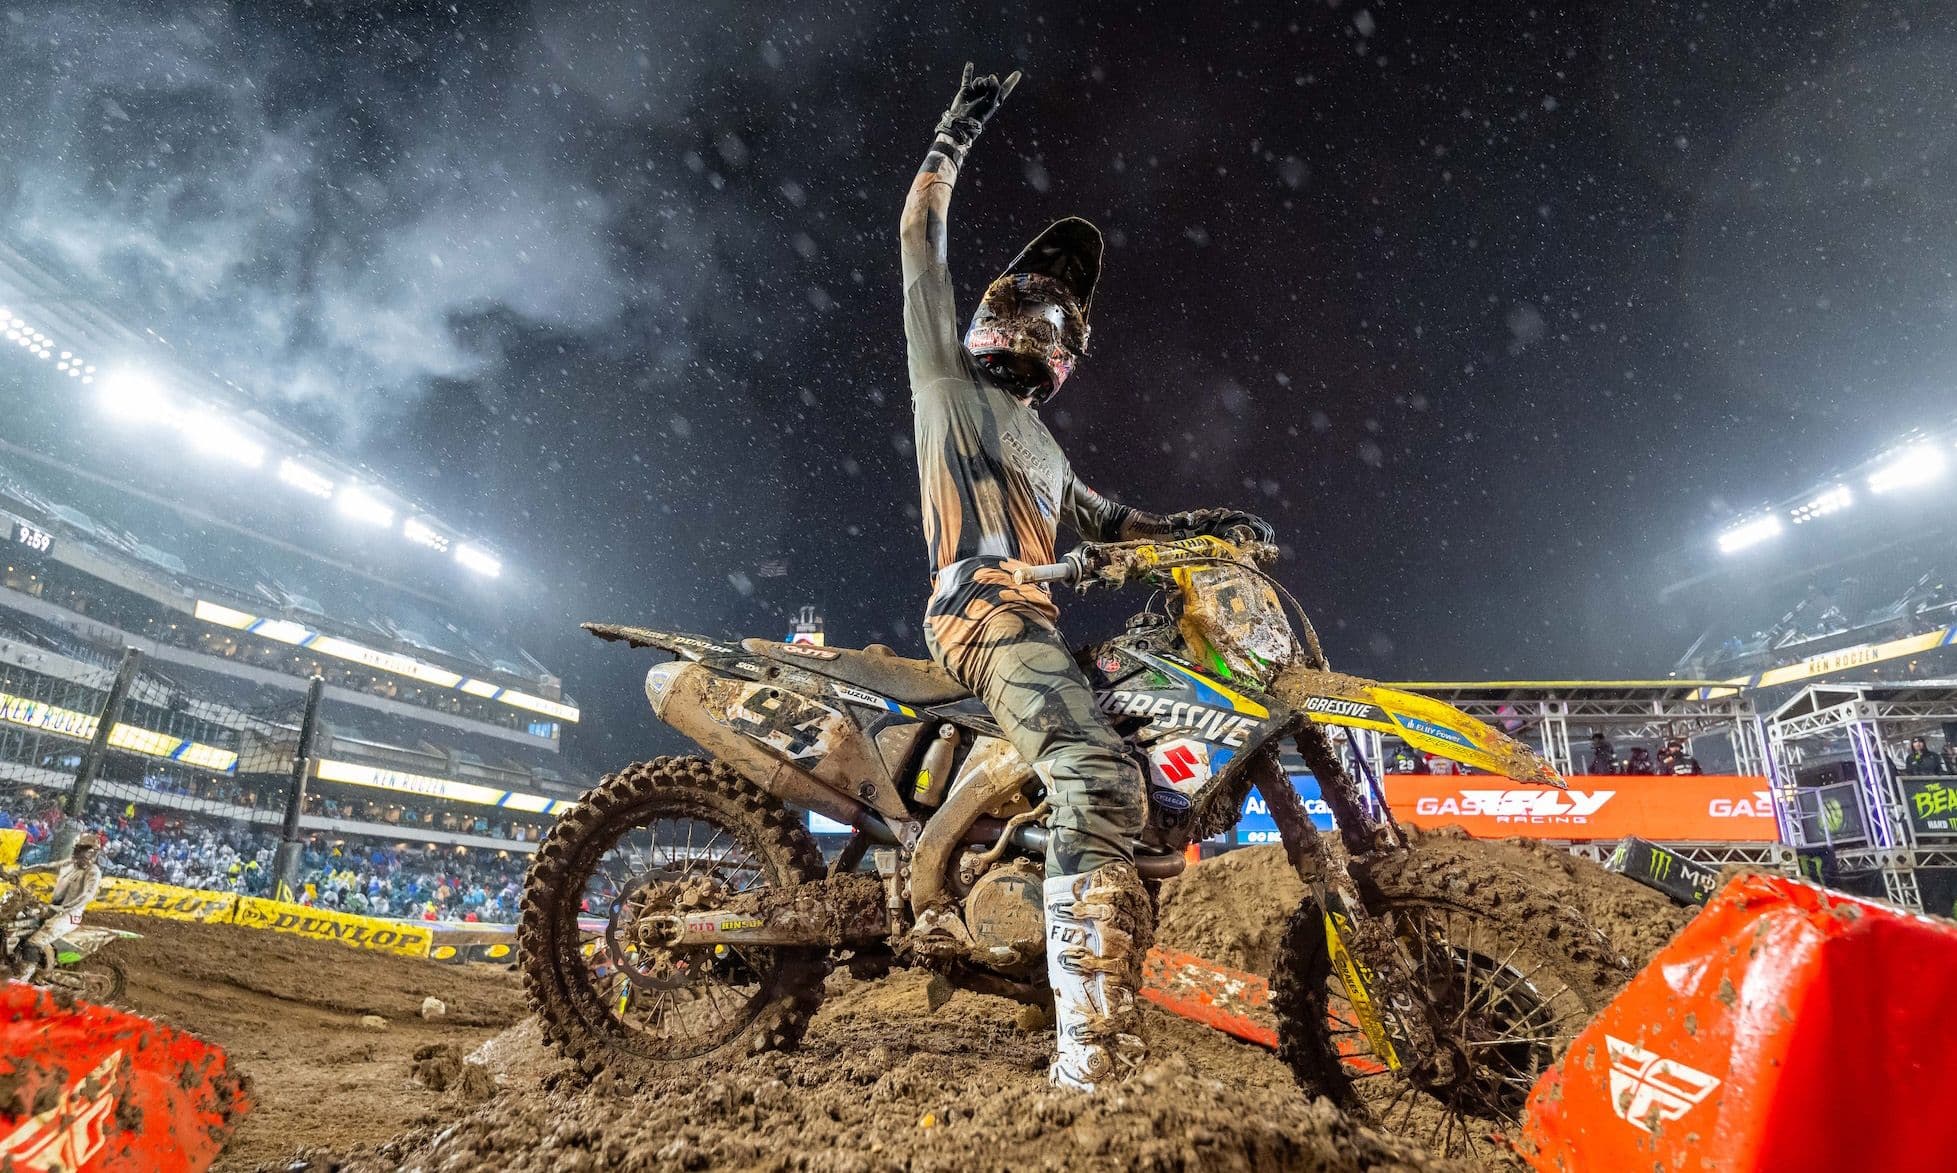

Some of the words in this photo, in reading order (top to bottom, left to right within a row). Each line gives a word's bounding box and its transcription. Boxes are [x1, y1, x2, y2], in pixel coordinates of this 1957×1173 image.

[20, 527, 50, 552] 9:59
[674, 636, 733, 653] DUNLOP
[1809, 658, 1829, 673] KEN
[1835, 648, 1879, 668] ROCZEN
[840, 688, 878, 704] SUZUKI
[0, 696, 38, 722] KEN
[1399, 759, 1415, 771] 29
[373, 773, 395, 788] KEN
[1925, 783, 1940, 791] THE
[1496, 816, 1588, 824] RACING
[1927, 820, 1949, 830] HARD
[270, 912, 424, 948] DUNLOP
